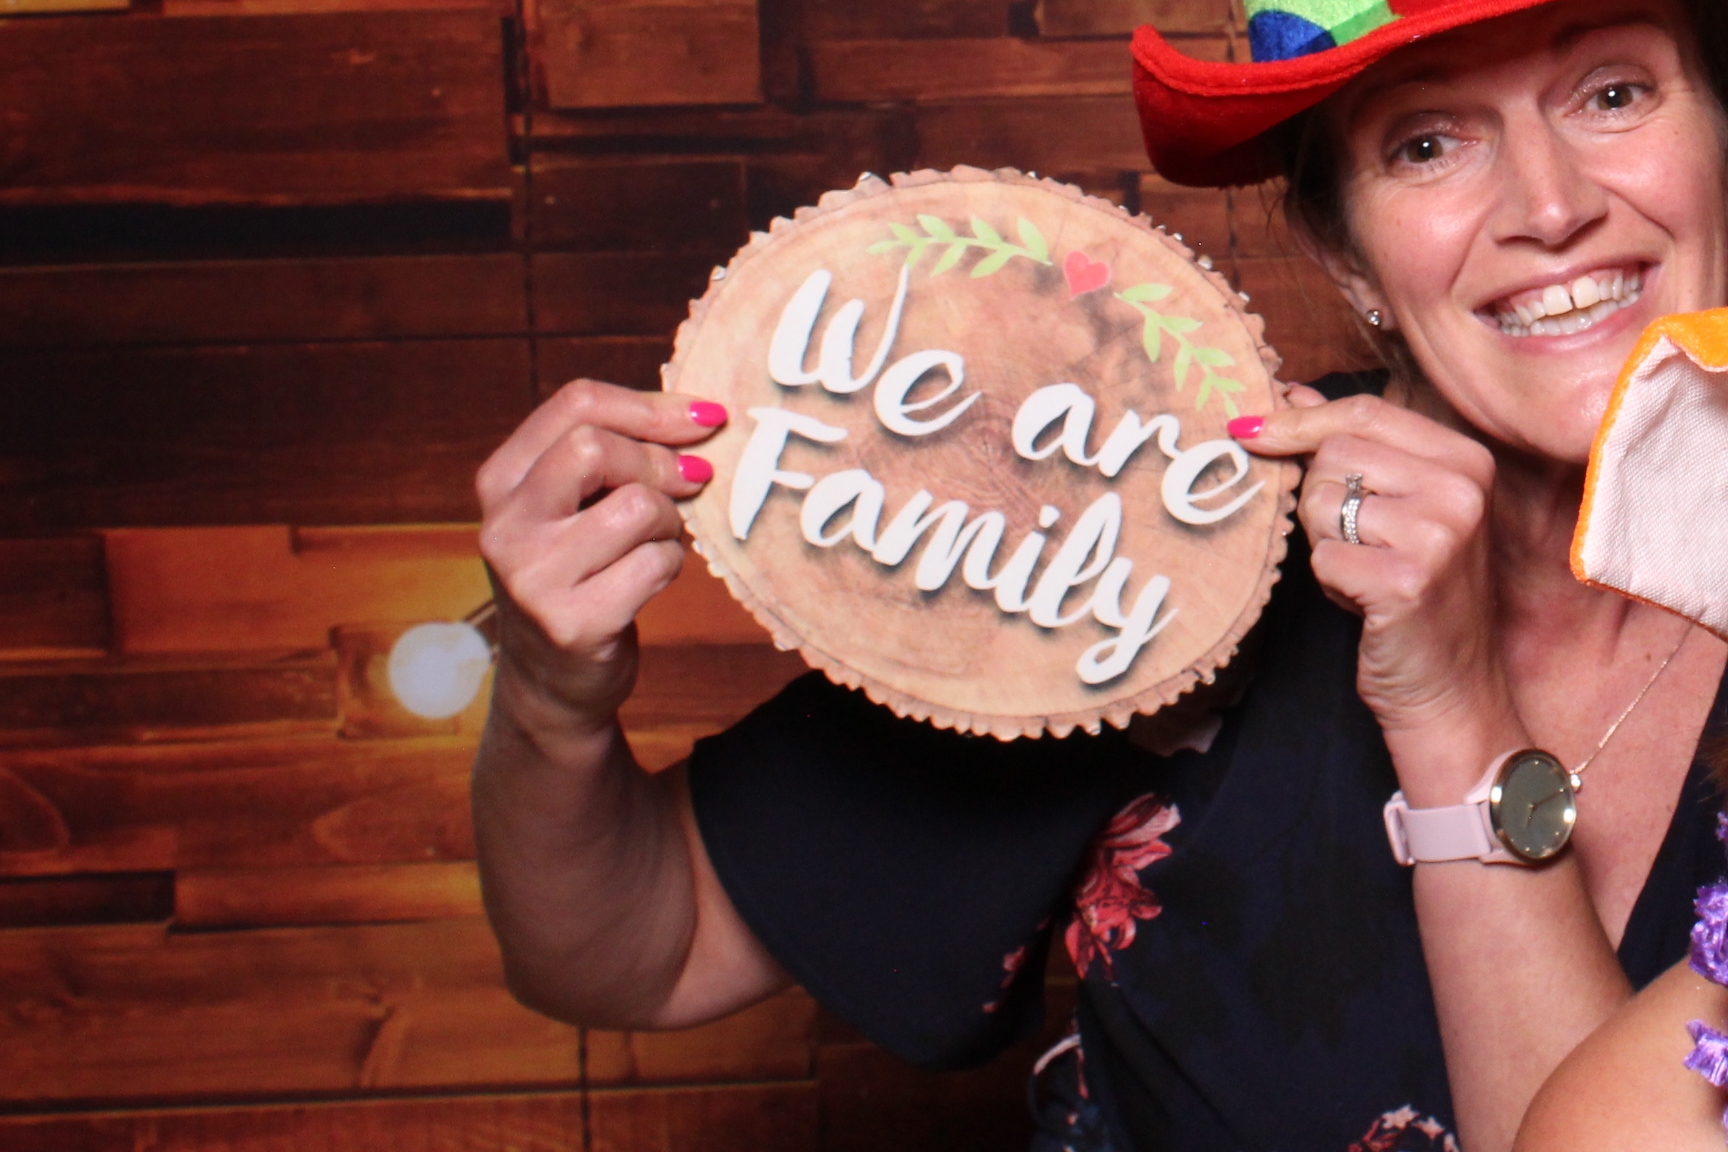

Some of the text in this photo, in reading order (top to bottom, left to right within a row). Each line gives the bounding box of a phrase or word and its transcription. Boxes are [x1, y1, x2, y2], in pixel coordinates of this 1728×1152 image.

[767, 263, 1265, 525] We are
[729, 407, 1179, 684] Family
